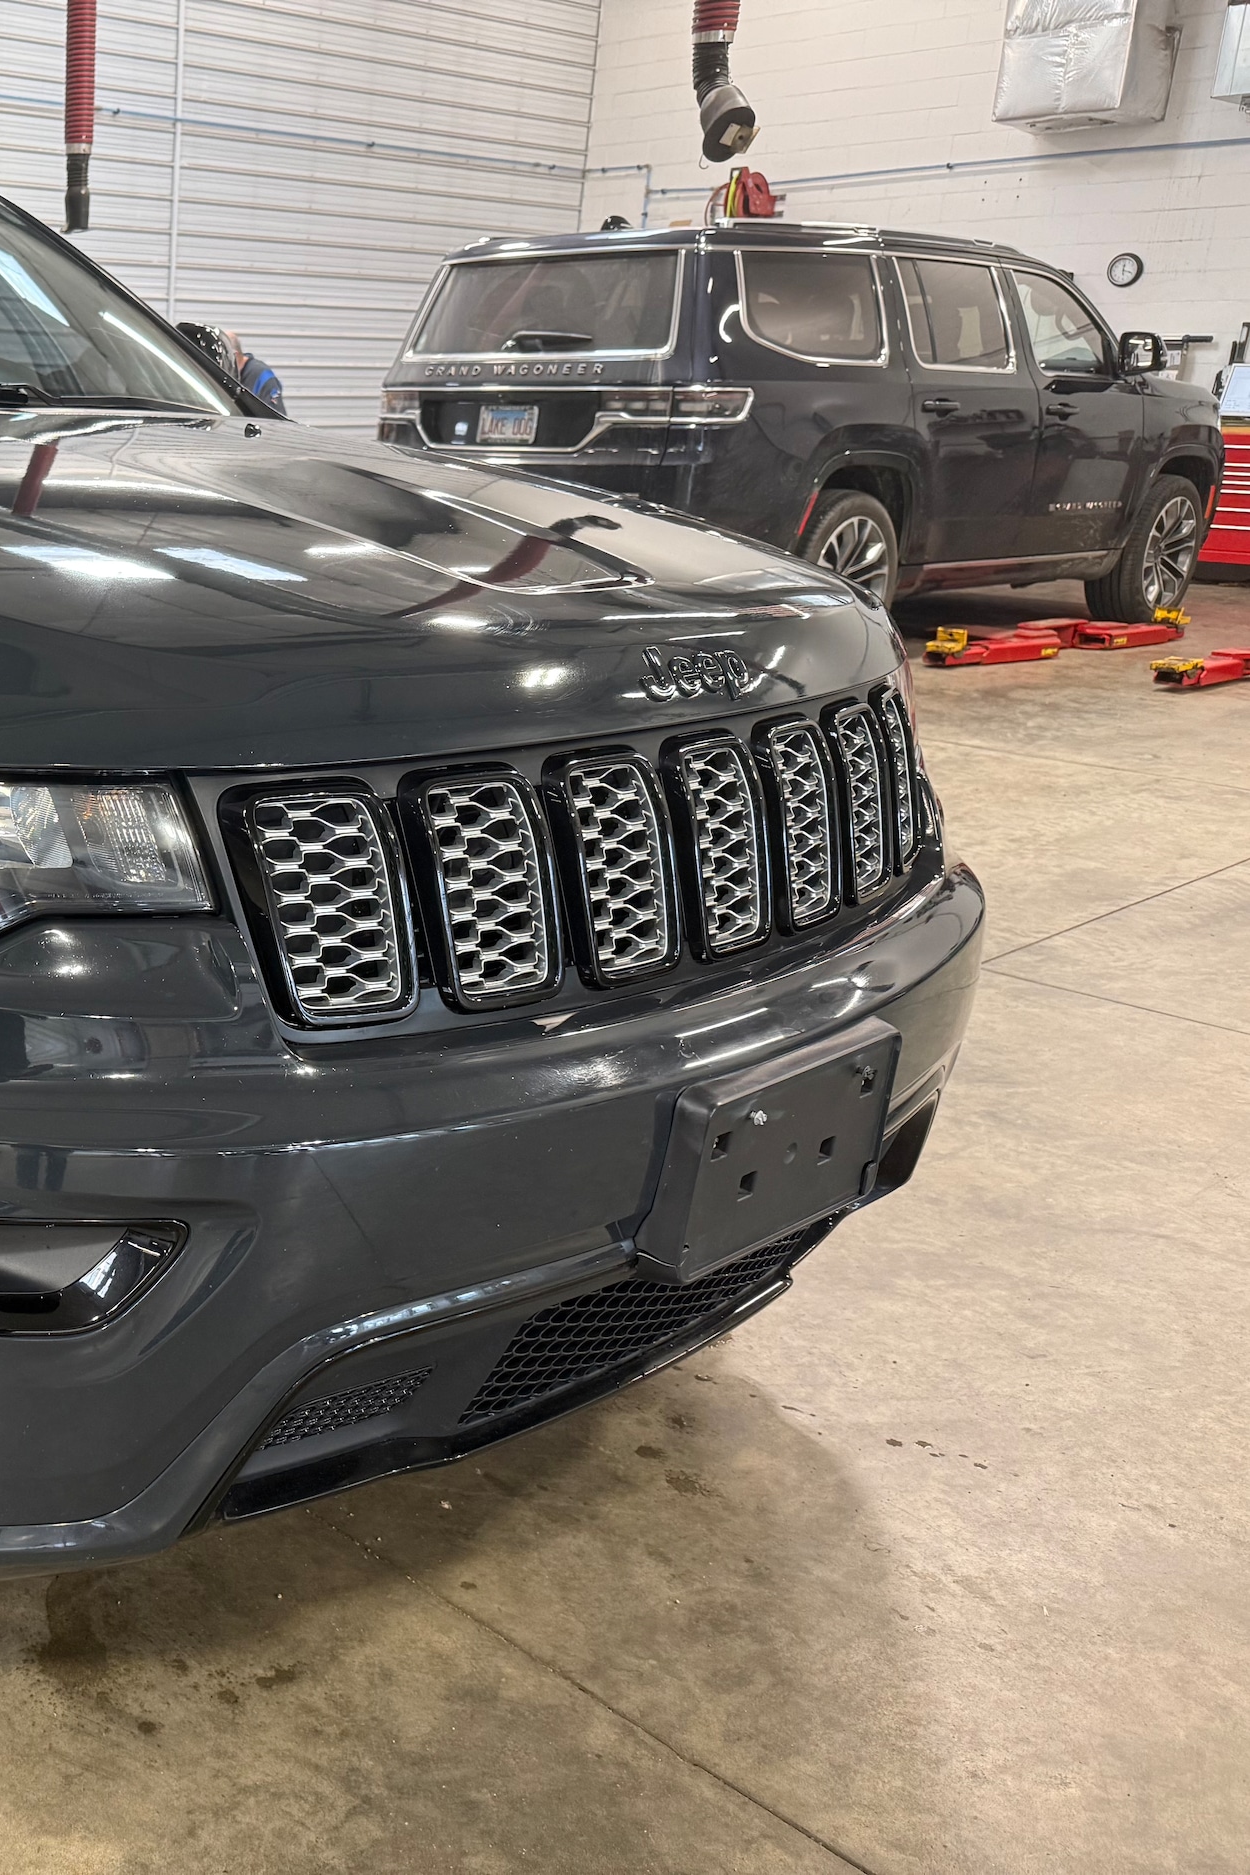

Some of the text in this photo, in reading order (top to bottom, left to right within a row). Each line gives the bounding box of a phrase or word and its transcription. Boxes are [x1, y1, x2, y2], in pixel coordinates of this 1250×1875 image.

[424, 362, 605, 377] GRAND WAGONEER
[481, 417, 508, 435] LAKE
[638, 646, 750, 702] Jeep
